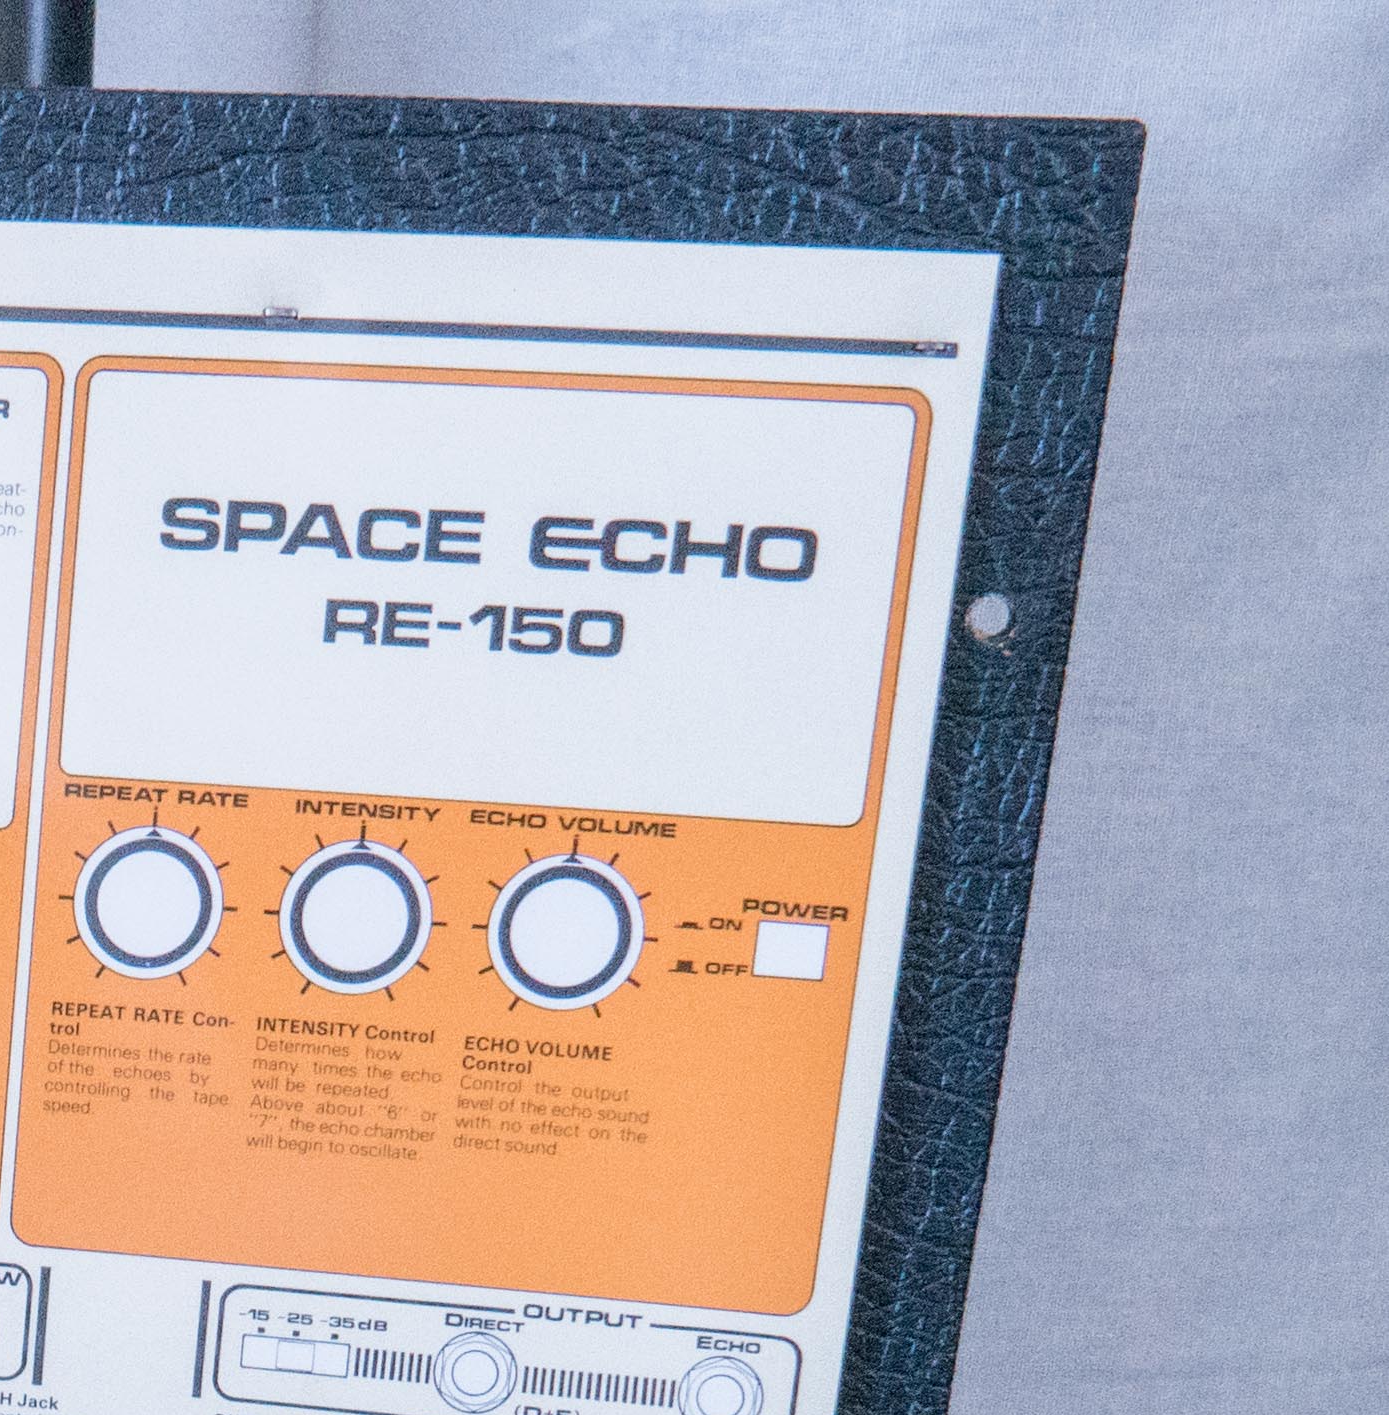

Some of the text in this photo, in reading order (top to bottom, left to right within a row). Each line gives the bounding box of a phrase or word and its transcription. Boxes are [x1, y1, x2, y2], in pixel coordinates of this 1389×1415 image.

[158, 496, 818, 583] SPACE ECHO
[322, 598, 625, 658] RE-150
[63, 782, 249, 808] REPEAT RATE
[294, 798, 440, 822] INTENSITY
[469, 808, 677, 839] ECHO VOLUME
[741, 897, 849, 922] POWER
[708, 916, 743, 932] ON
[704, 960, 748, 976] OFF
[50, 999, 235, 1028] REPEAT RATE Con-
[48, 1021, 80, 1036] trol
[256, 1016, 435, 1044] INTENSITY Control
[463, 1034, 612, 1062] ECHO VOLUME
[460, 1053, 532, 1074] Control
[521, 1302, 643, 1329] OUTPUT
[16, 1392, 58, 1410] Jack
